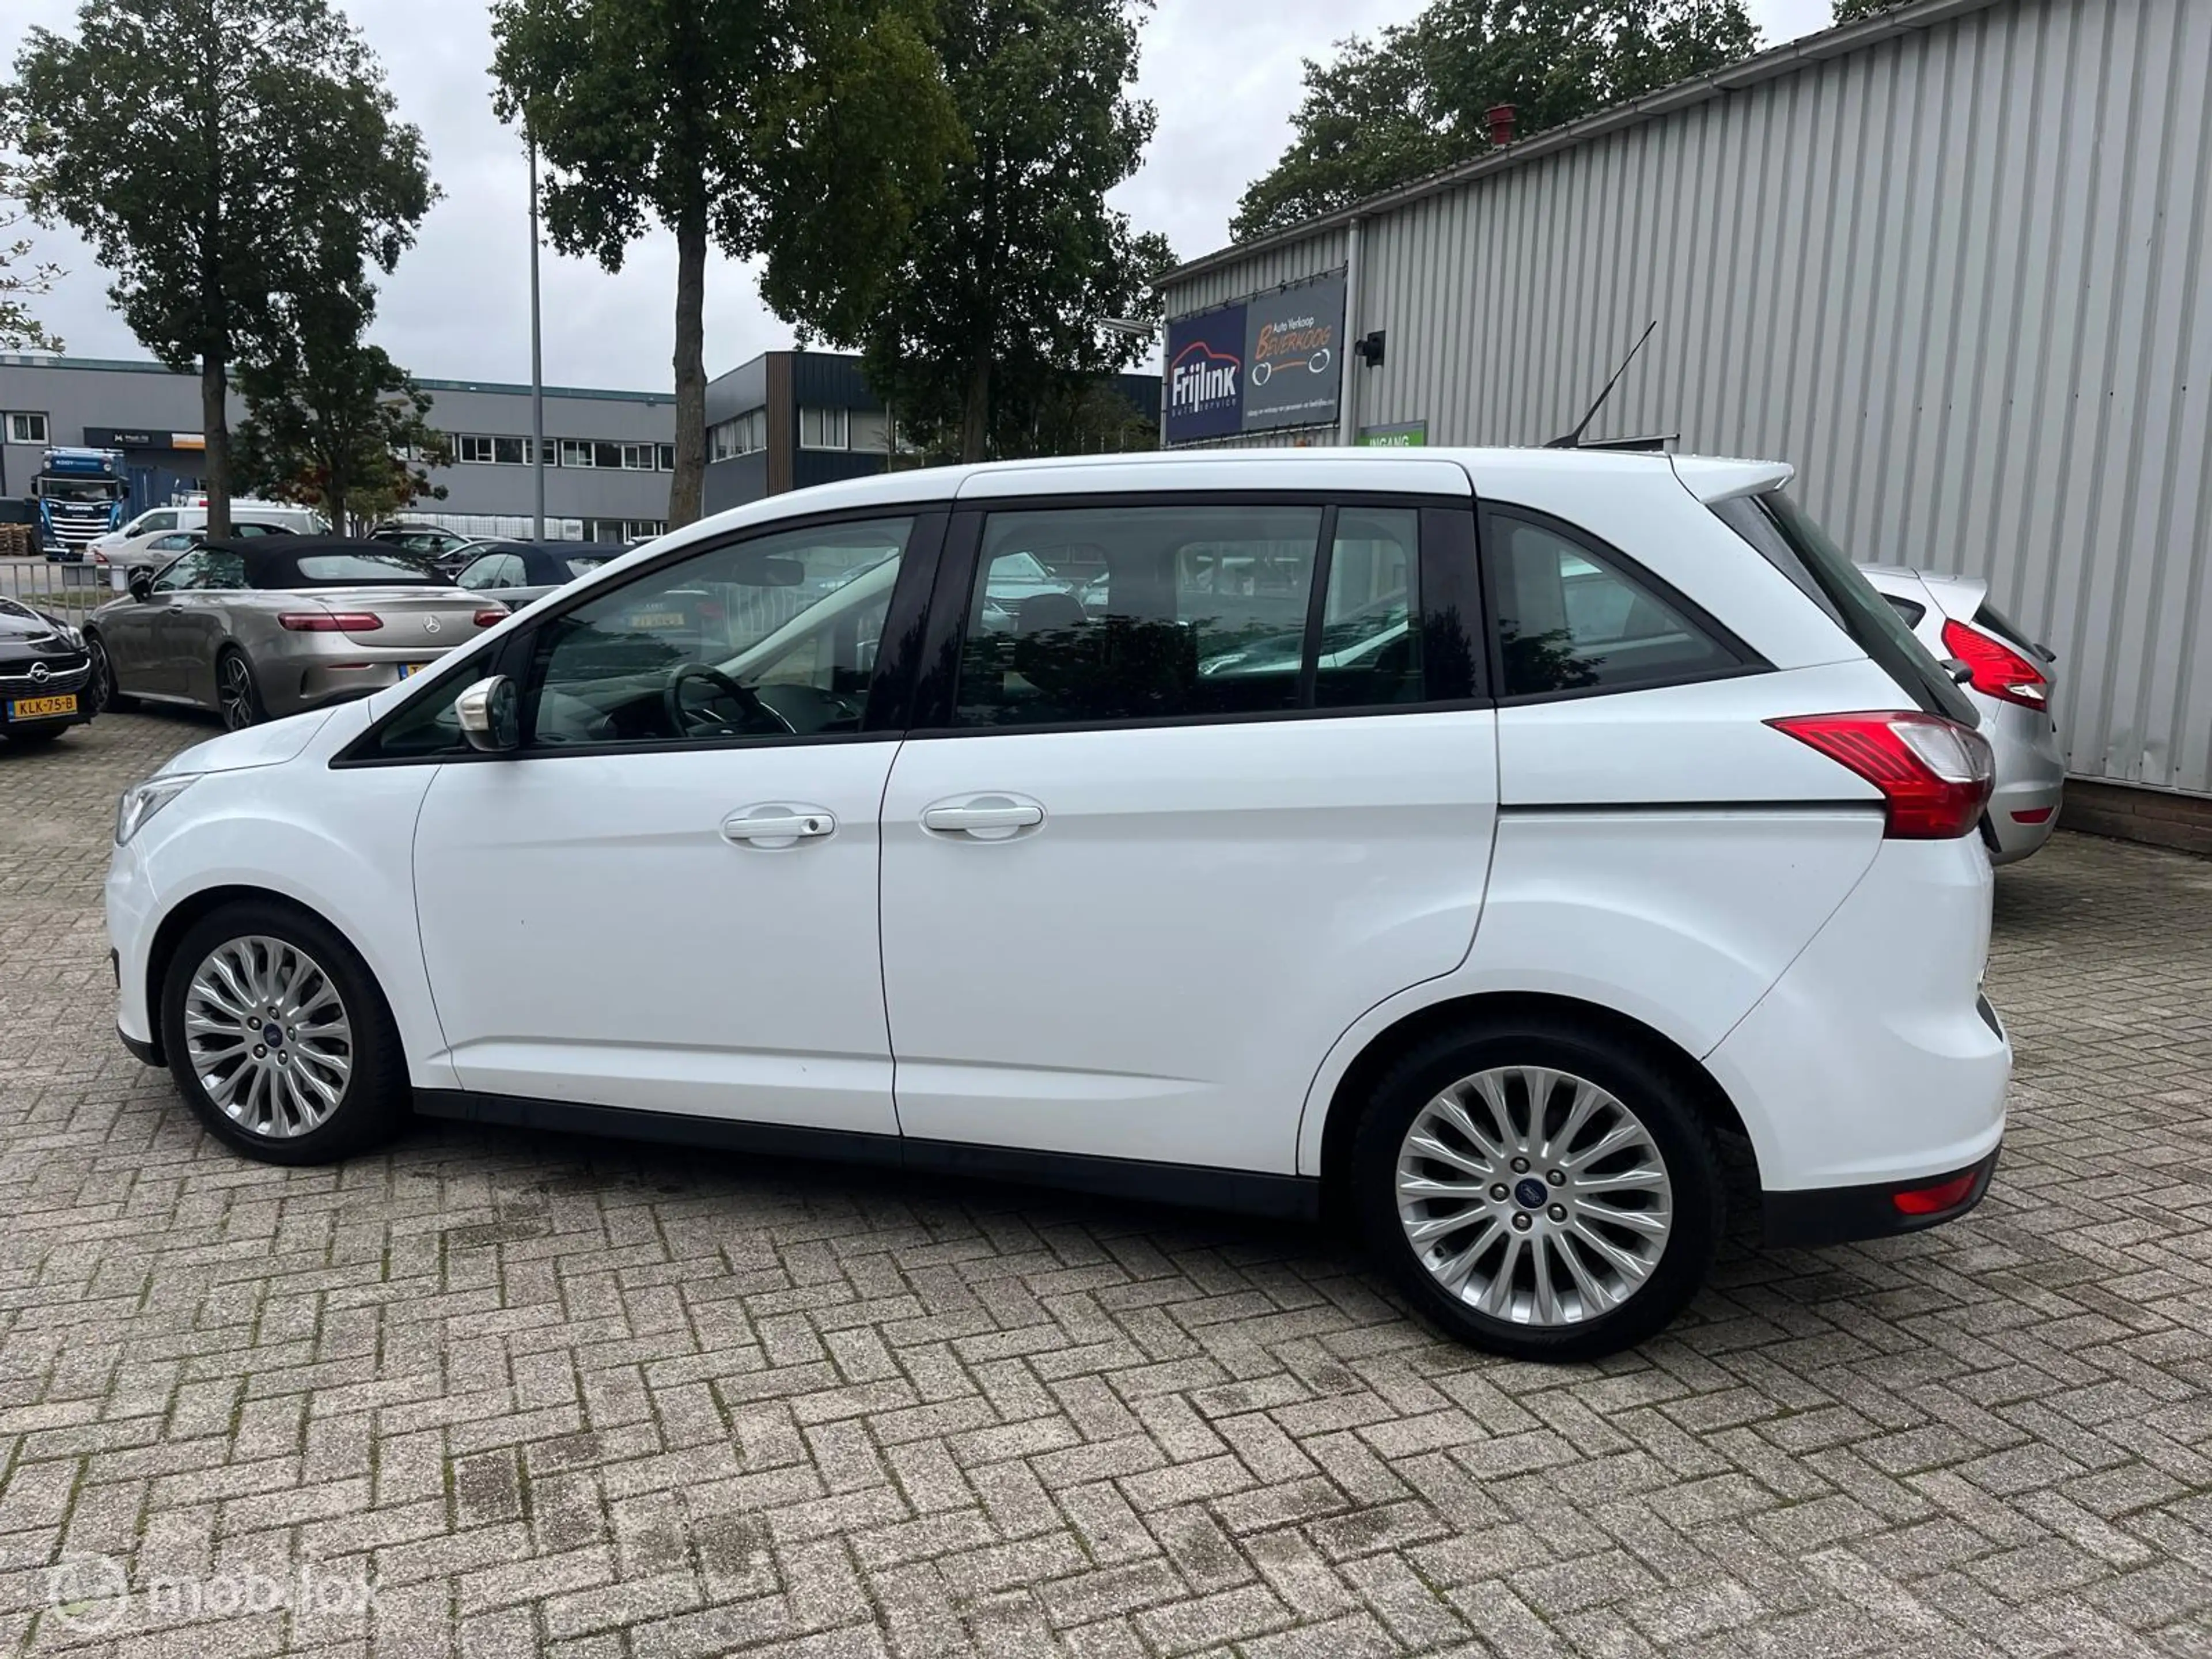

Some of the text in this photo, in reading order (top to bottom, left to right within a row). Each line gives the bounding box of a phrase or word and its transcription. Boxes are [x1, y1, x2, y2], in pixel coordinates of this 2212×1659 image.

[1172, 361, 1236, 412] Frijlink
[1369, 435, 1410, 446] INGANG
[20, 696, 73, 714] KLK-75-B
